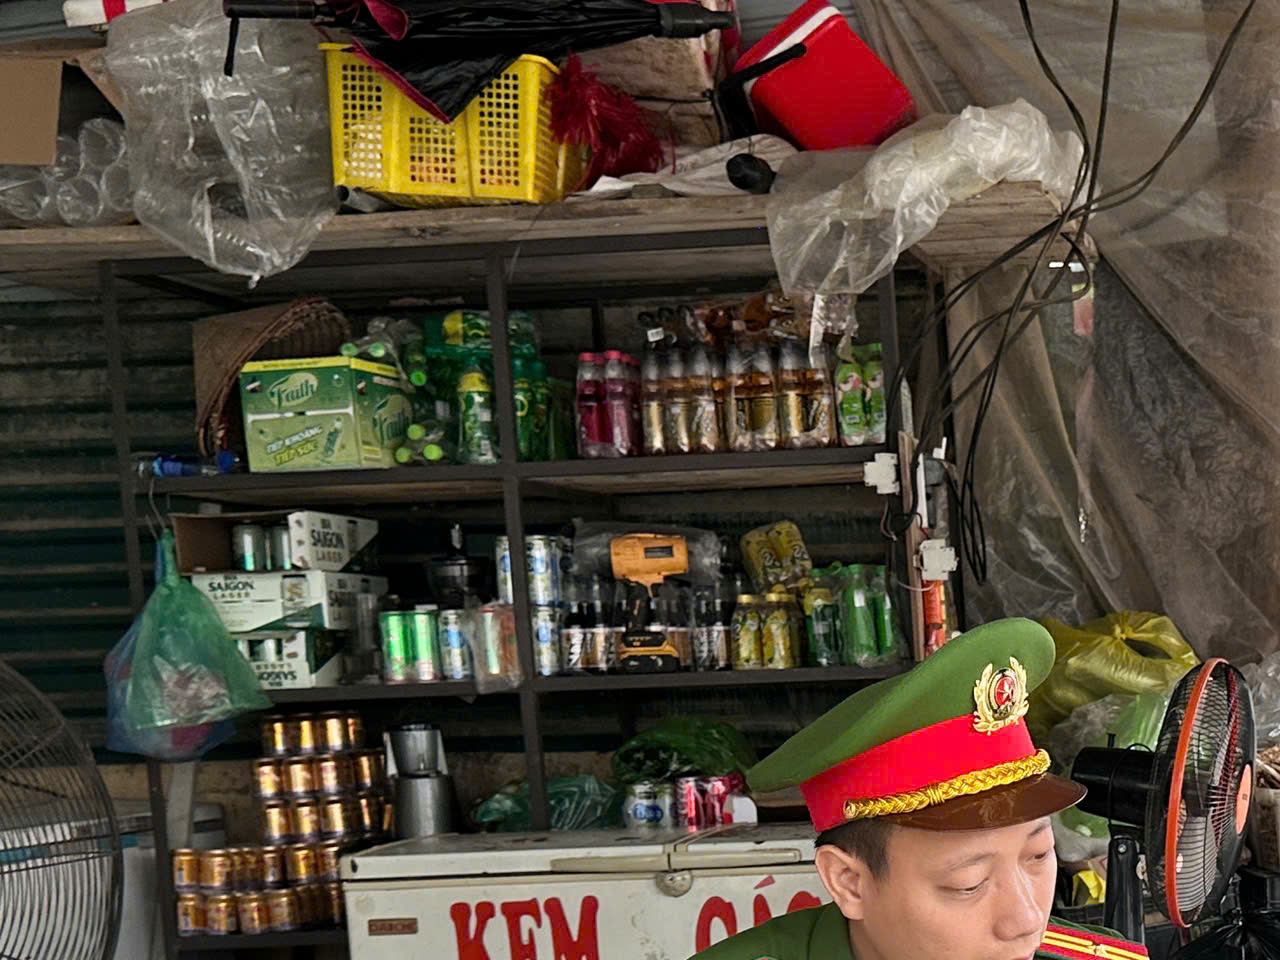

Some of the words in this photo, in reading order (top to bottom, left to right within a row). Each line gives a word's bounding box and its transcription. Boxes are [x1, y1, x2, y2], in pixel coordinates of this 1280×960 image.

[269, 379, 316, 409] Faith
[311, 529, 345, 550] SAIGON
[208, 581, 255, 592] SAIGON
